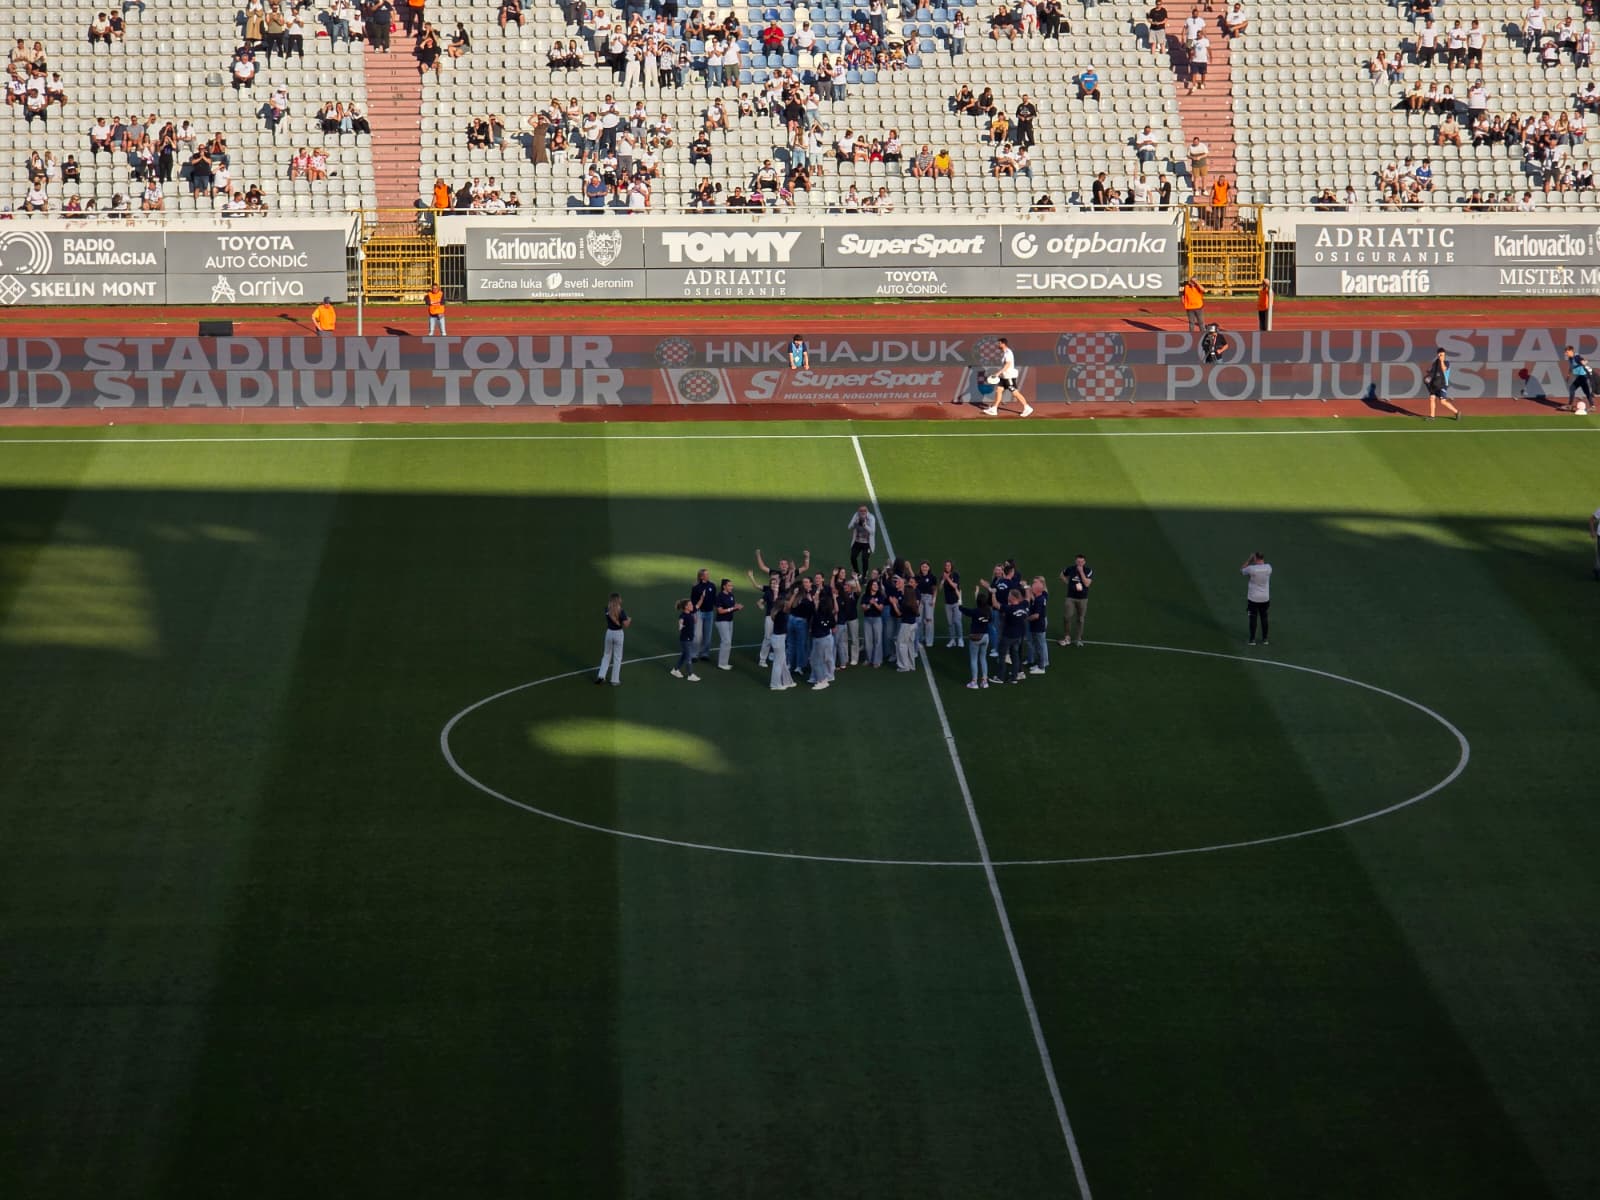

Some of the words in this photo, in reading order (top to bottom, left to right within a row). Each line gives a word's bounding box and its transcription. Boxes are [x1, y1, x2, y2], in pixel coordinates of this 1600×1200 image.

[64, 239, 115, 251] RADIO
[217, 236, 294, 251] TOYOTA
[662, 231, 802, 263] TOMMY
[837, 233, 985, 258] SuperSport
[1046, 231, 1167, 259] otpbanka
[1315, 227, 1455, 248] ADRIATIC
[1494, 233, 1586, 257] Karlovačko
[485, 237, 577, 260] Karlovačko
[1315, 251, 1455, 264] OSIGURANJE
[63, 252, 157, 265] DALMACIJA
[205, 256, 245, 269] AUTO
[248, 252, 308, 269] ČONDIĆ
[240, 276, 304, 296] arriva
[480, 278, 518, 289] Zračna
[520, 278, 543, 289] luka
[564, 278, 589, 289] sveti
[591, 278, 634, 289] Jeronim
[684, 269, 786, 285] ADRIATIC
[885, 271, 938, 282] TOYOTA
[1016, 273, 1163, 290] EURODAUS
[1499, 268, 1576, 286] MISTER
[1580, 268, 1600, 286] M
[30, 282, 95, 297] SKELIN
[102, 281, 157, 297] MONT
[684, 287, 787, 296] OSIGURANJE
[876, 284, 905, 294] AUTO
[905, 282, 948, 294] ČONDIĆ
[83, 336, 401, 371] STADIUM
[421, 335, 613, 370] TOUR
[705, 341, 788, 363] HNK
[805, 340, 965, 363] HAJDUK
[1156, 330, 1413, 365] POLJUD
[93, 368, 411, 408] STADIUM
[431, 368, 625, 406] TOUR
[792, 369, 944, 390] SuperSport
[1166, 362, 1423, 401] POLJUD
[784, 392, 839, 400] HRVATSKA
